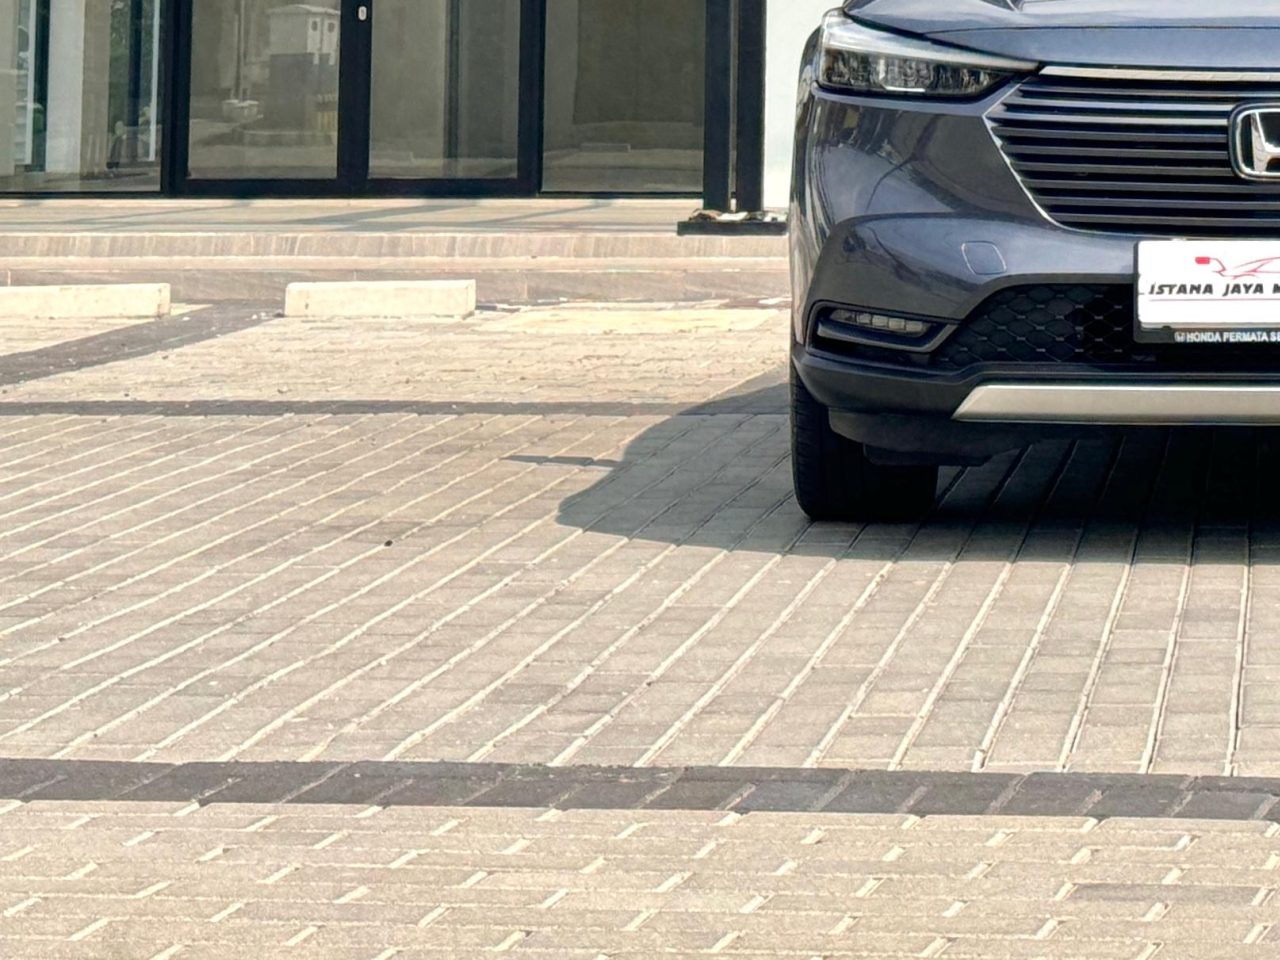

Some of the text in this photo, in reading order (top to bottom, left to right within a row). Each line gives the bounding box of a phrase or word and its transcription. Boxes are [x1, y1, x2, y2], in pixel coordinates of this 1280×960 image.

[1148, 283, 1213, 295] ISTANA
[1222, 283, 1264, 297] JAYA
[1186, 331, 1221, 343] HONDA
[1223, 331, 1269, 343] PERMATA
